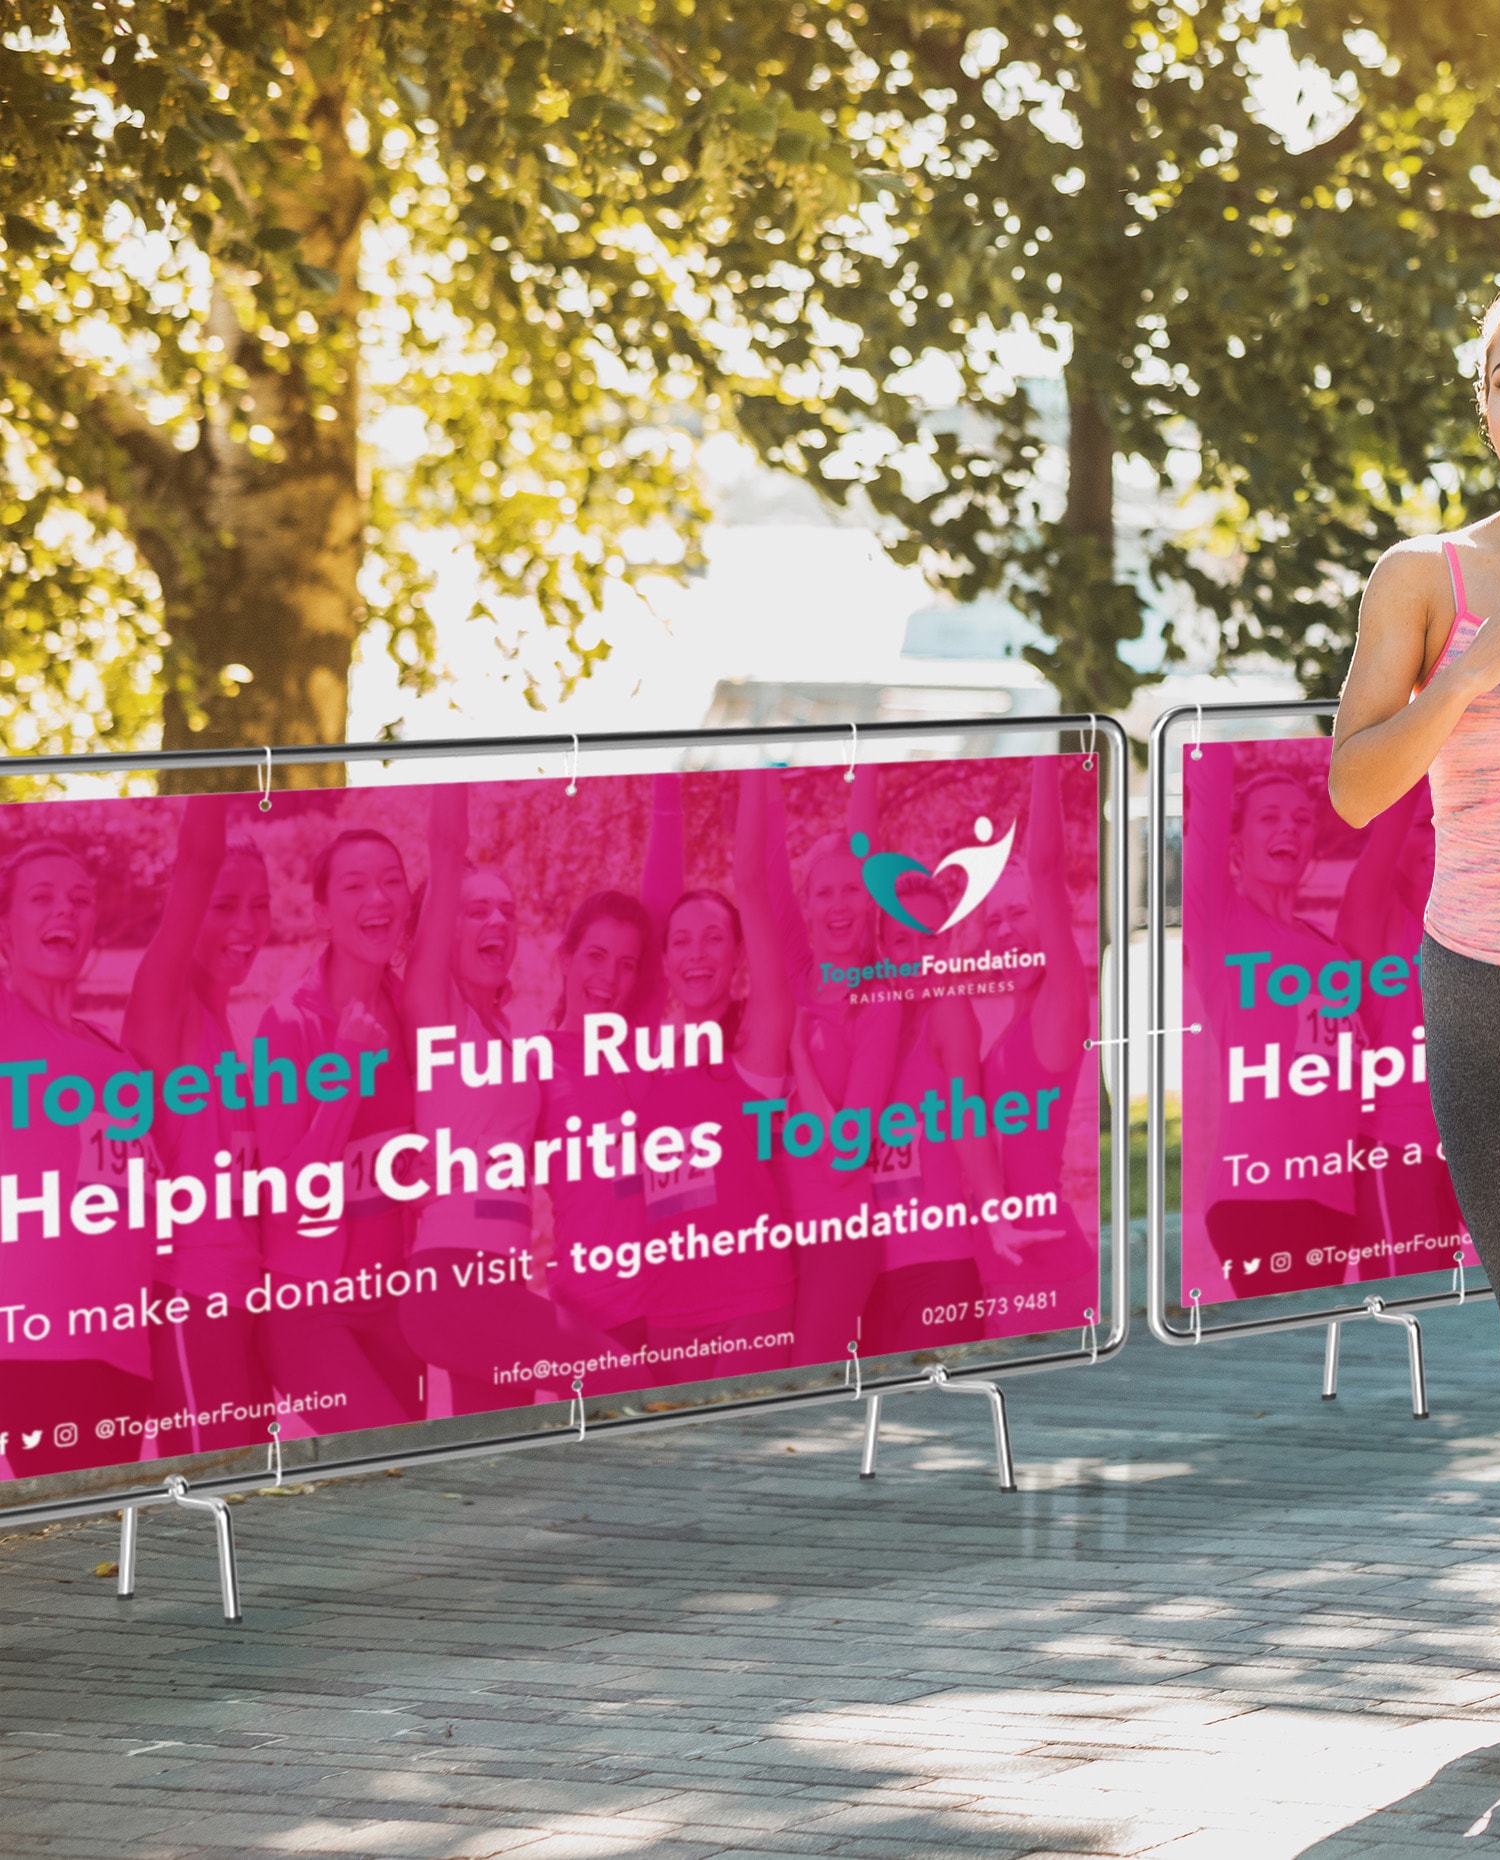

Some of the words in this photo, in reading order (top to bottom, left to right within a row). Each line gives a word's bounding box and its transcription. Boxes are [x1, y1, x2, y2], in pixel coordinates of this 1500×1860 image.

[818, 945, 1048, 989] TogetherFoundation
[849, 985, 915, 1005] RAISING
[921, 979, 1016, 999] AWARENESS
[1224, 943, 1423, 1019] Toge
[0, 1036, 389, 1142] Together
[416, 1024, 554, 1092] Fun
[583, 1012, 724, 1077] Run
[1228, 1025, 1426, 1113] Helpi
[0, 1150, 345, 1255] Helping
[374, 1110, 722, 1201] Charities
[742, 1077, 1060, 1171] Together
[1223, 1153, 1270, 1187] To
[1285, 1139, 1389, 1180] make
[1402, 1142, 1422, 1165] a
[0, 1304, 51, 1343] To
[68, 1287, 190, 1336] make
[206, 1292, 228, 1319] a
[245, 1262, 437, 1314] donation
[452, 1246, 534, 1288] visit
[570, 1191, 1057, 1279] togetherfoundation.com
[922, 1302, 968, 1325] 0207
[975, 1297, 1008, 1318] 573
[1013, 1290, 1056, 1312] 9481
[492, 1330, 796, 1386] info@togetherfoundation.com
[94, 1389, 348, 1441] @TogetherFoundation
